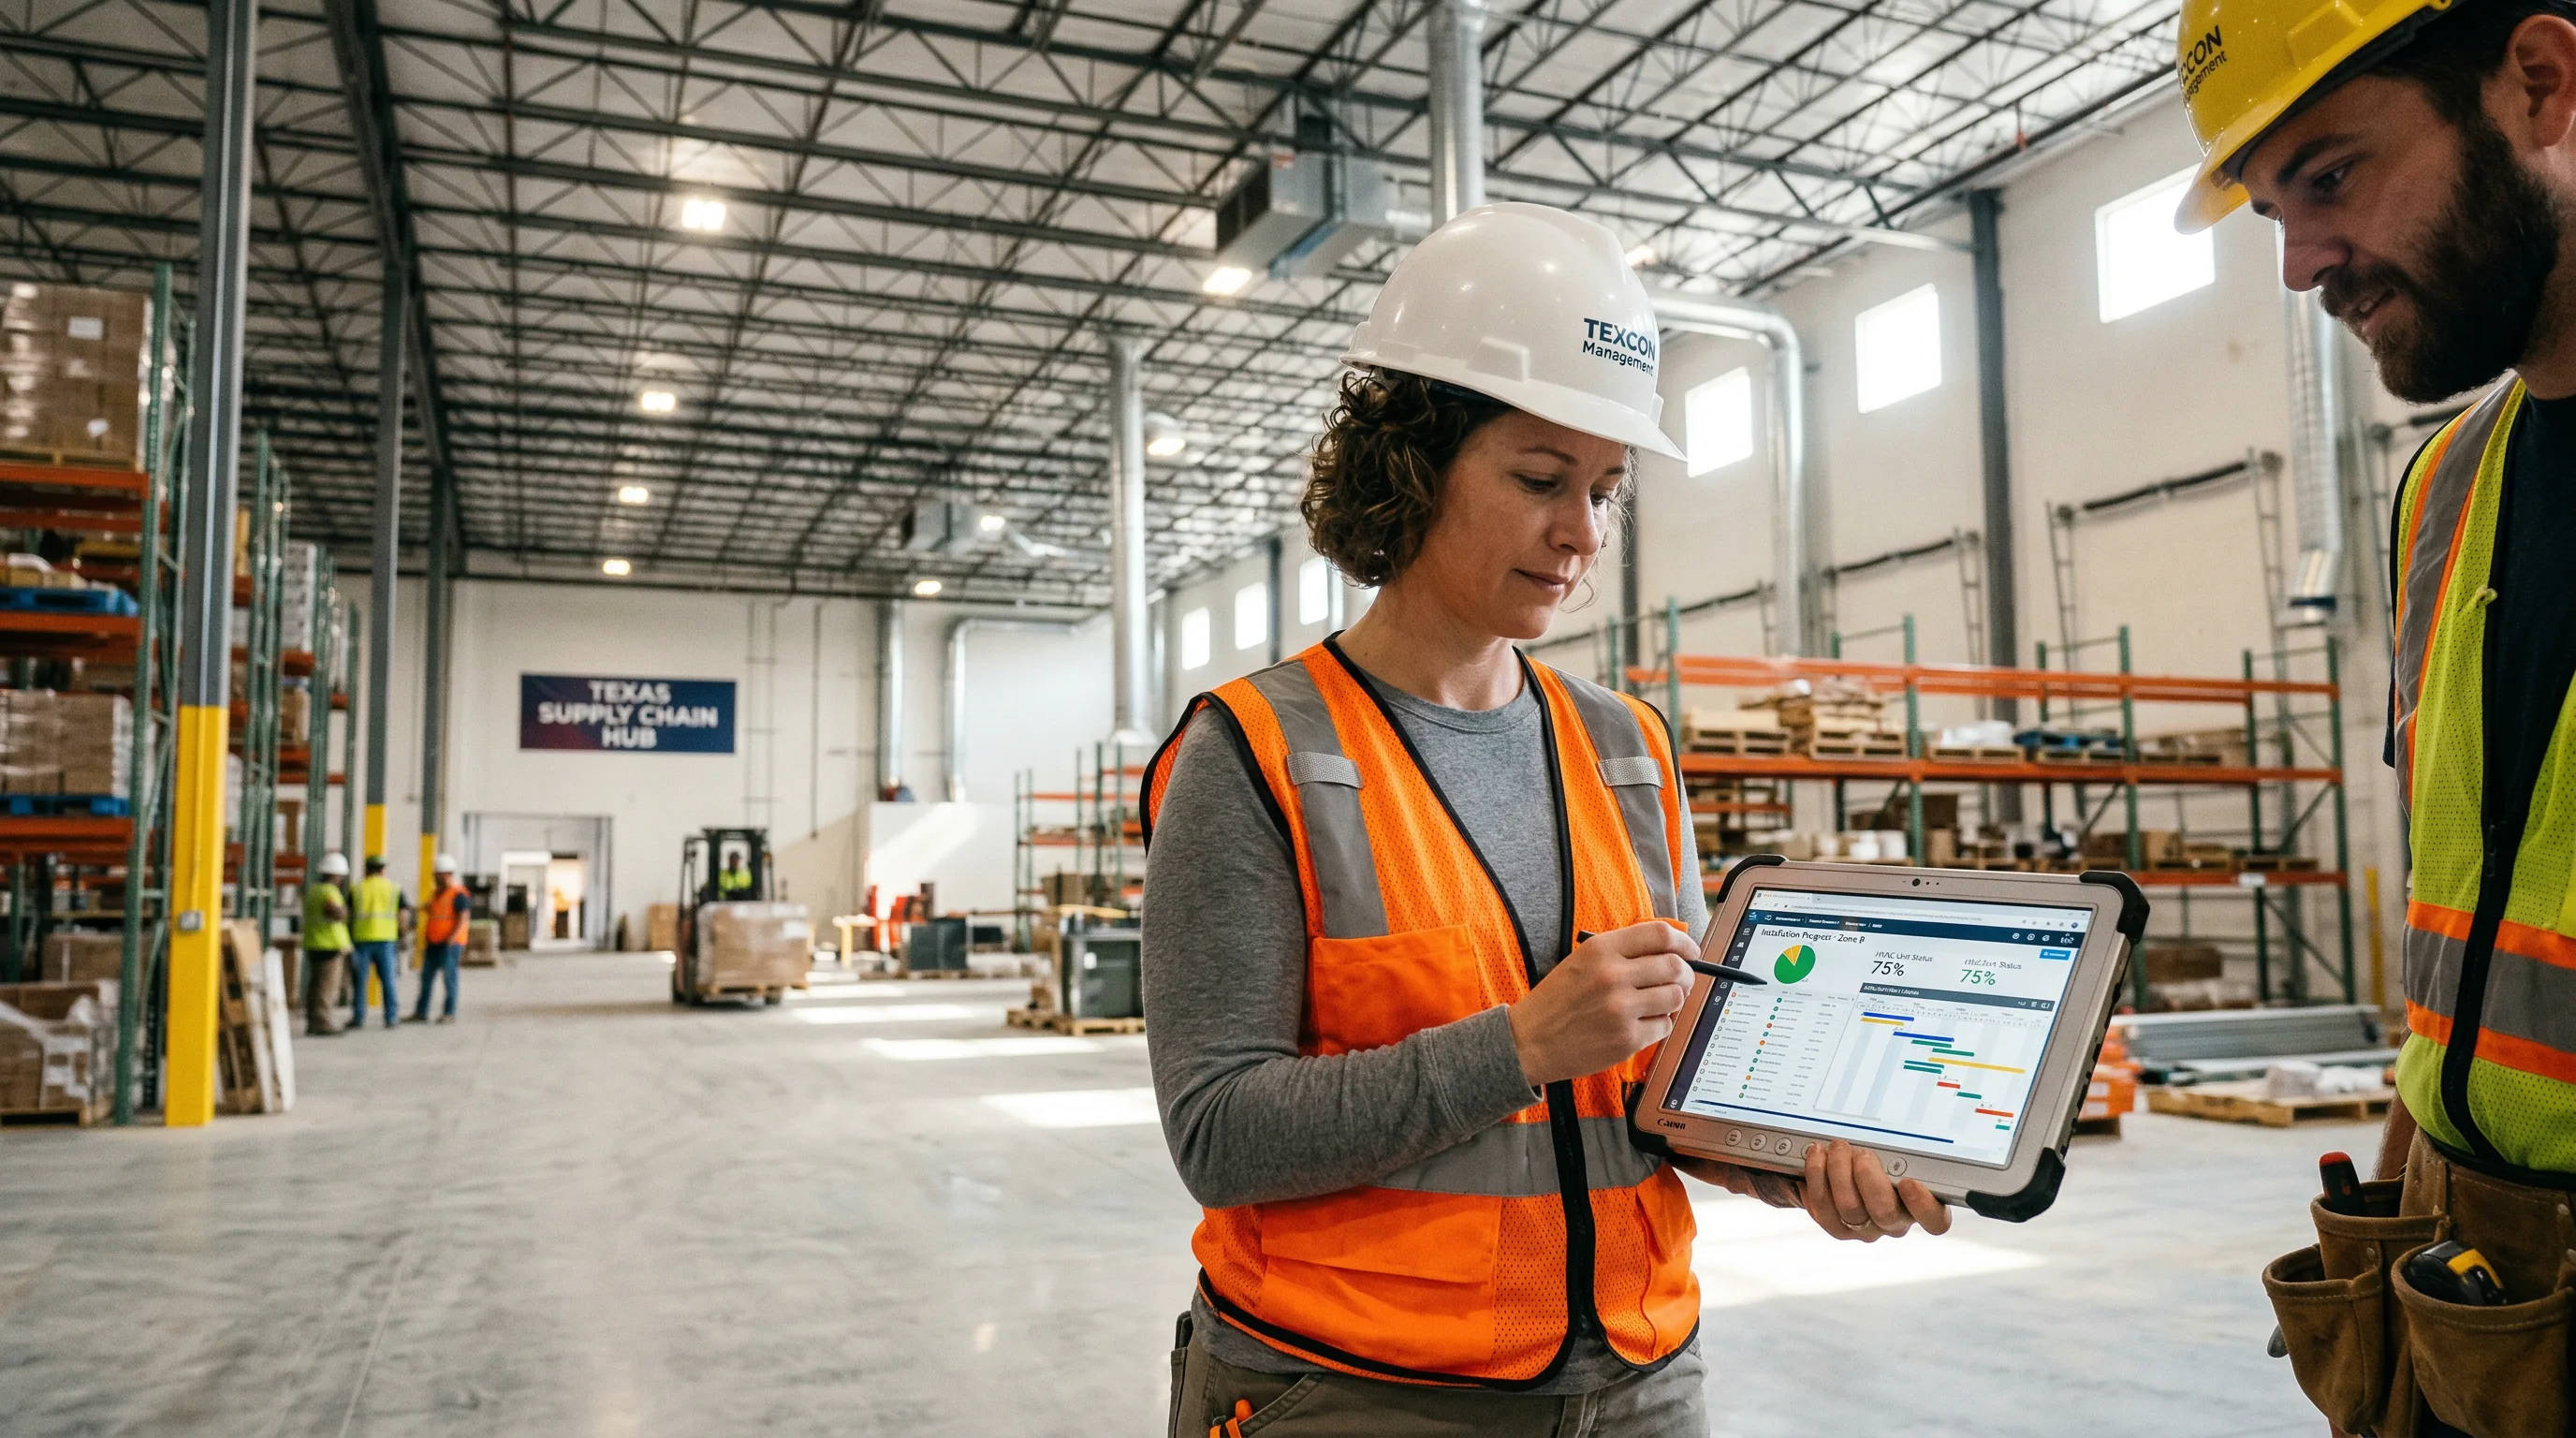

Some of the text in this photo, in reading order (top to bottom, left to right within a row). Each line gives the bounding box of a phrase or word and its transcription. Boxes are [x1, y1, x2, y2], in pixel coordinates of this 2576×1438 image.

[1583, 317, 1656, 361] TEXCON
[1582, 340, 1654, 376] Management
[588, 681, 671, 704] TEXAS
[538, 701, 718, 727] SUPPLY CHAIN
[601, 726, 657, 748] HUB
[1837, 933, 1858, 944] Zone
[1871, 961, 1904, 976] 75%
[1960, 969, 1996, 985] 75%
